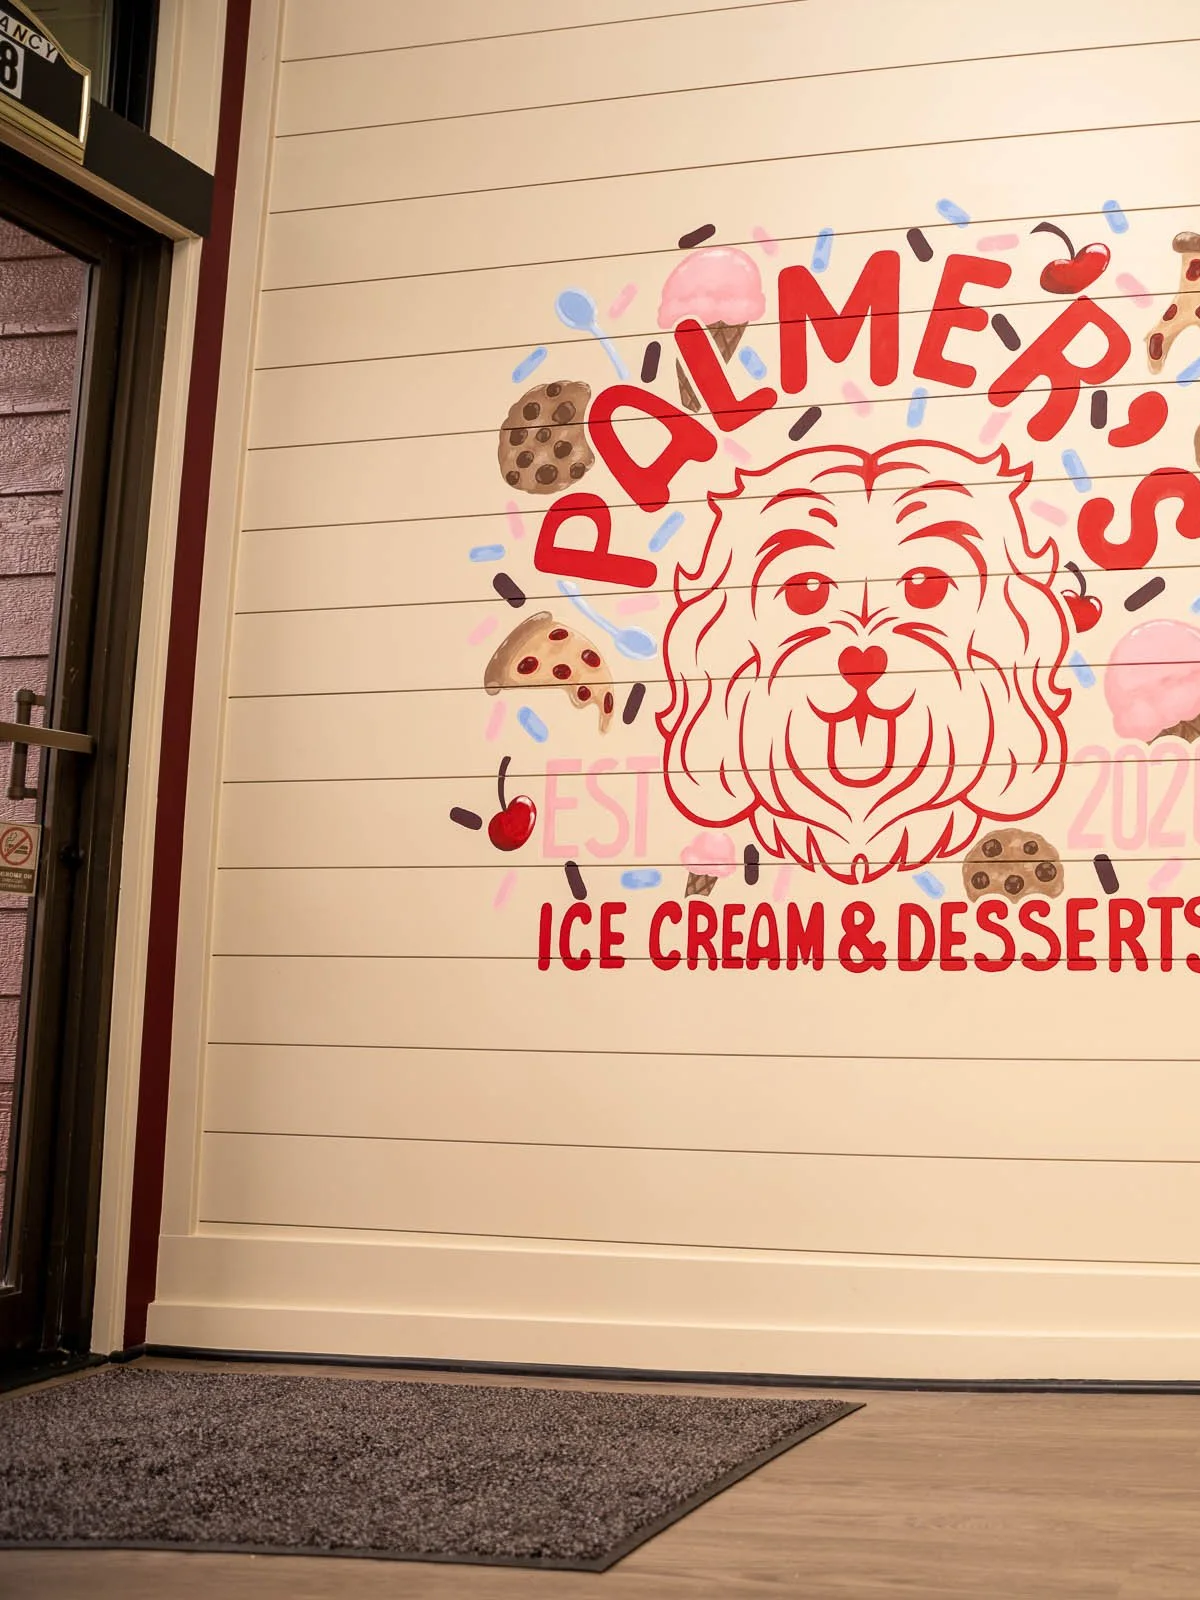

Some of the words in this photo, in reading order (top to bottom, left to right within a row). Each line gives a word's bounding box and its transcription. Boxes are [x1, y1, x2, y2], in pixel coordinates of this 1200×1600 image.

[543, 756, 660, 858] EST
[537, 901, 627, 971] ICE
[648, 900, 825, 972] CREAM
[837, 900, 887, 974] &
